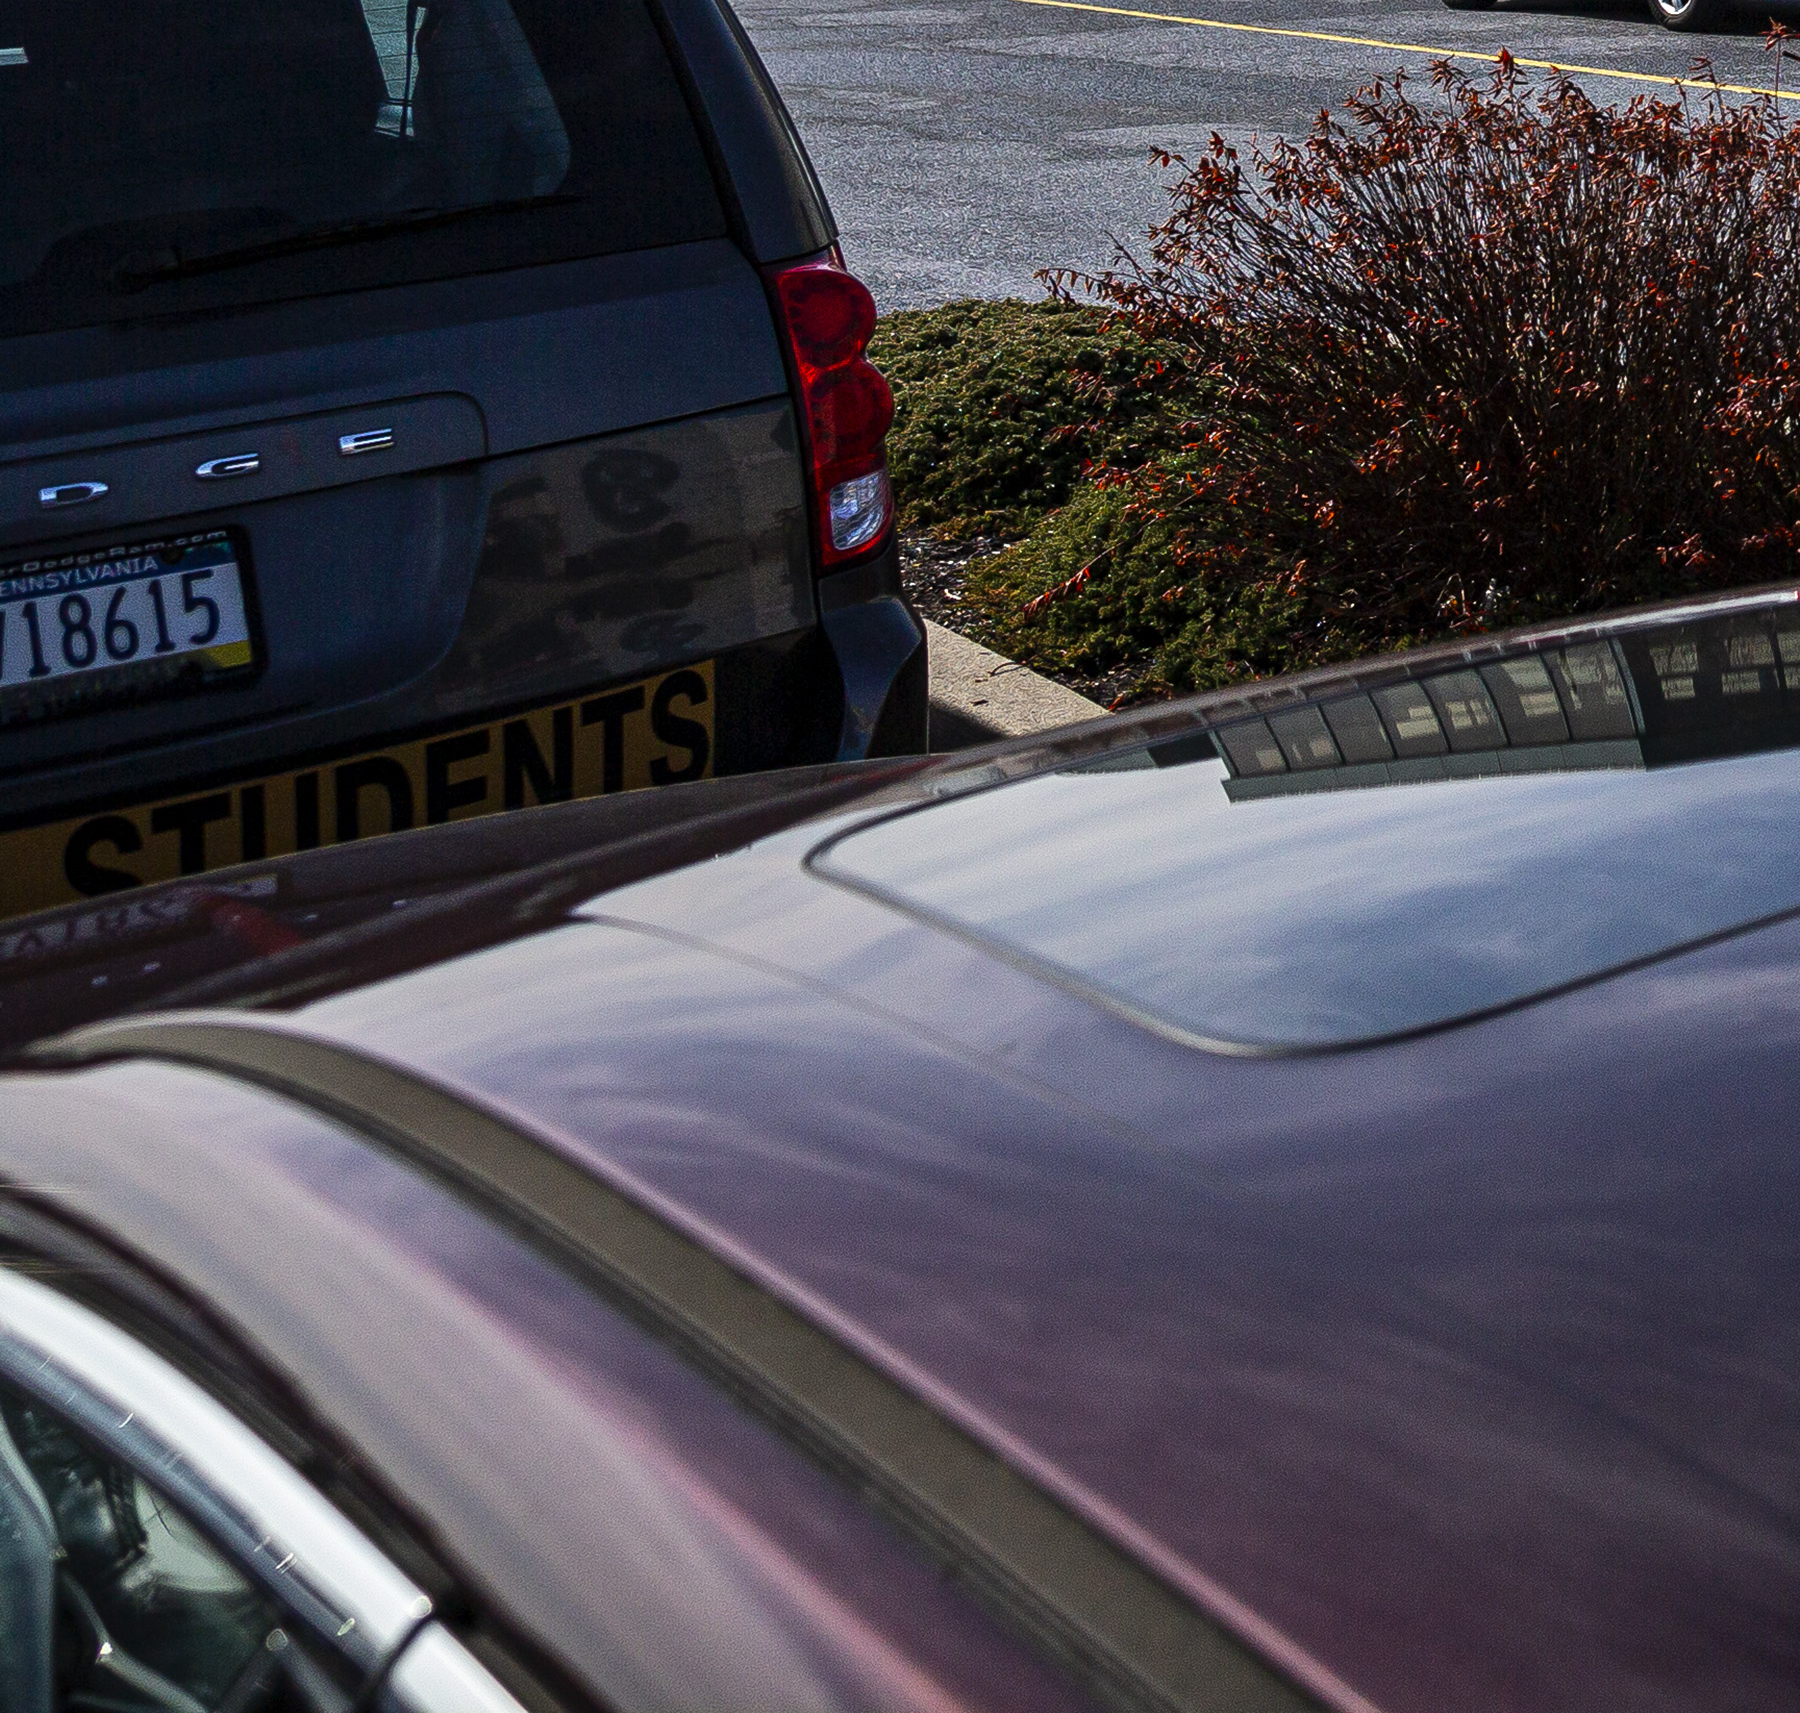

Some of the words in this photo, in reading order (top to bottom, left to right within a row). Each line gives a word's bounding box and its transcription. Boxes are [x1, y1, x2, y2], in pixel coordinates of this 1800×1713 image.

[39, 428, 394, 509] DGE
[0, 530, 227, 577] rDodgeRam.com
[0, 555, 158, 598] ENNSYLVANIA
[0, 568, 221, 681] 18615
[62, 669, 712, 896] STUDENTS
